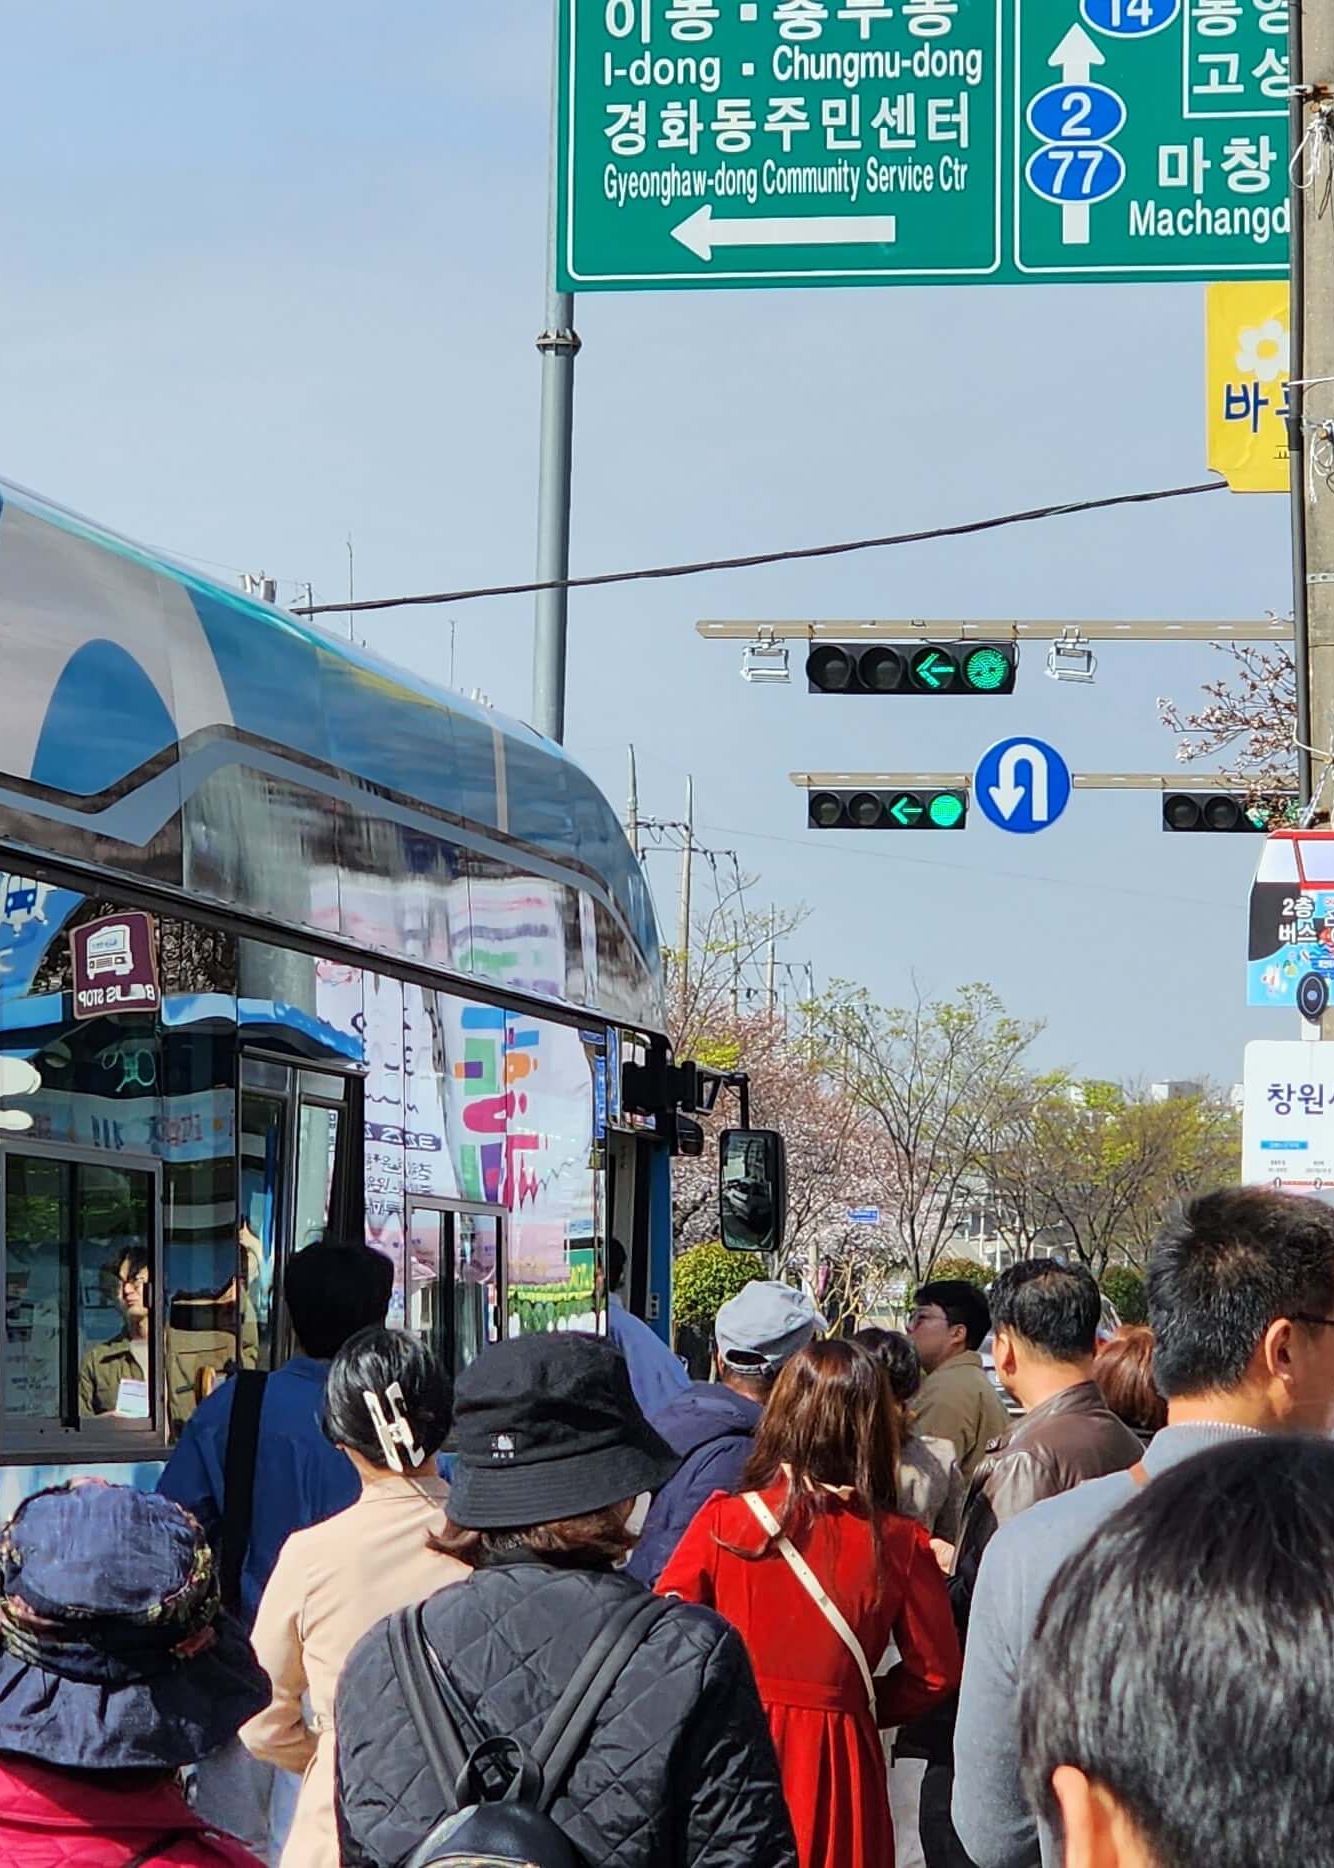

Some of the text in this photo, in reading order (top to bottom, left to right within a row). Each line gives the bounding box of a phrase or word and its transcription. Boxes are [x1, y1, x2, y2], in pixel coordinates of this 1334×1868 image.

[603, 43, 983, 92] I-dong Chungmu-dong
[603, 91, 971, 156] 경화동주민센터
[1061, 92, 1093, 137] 2
[763, 157, 860, 202] Community
[866, 155, 933, 193] Service
[939, 154, 969, 191] Ctr
[1047, 150, 1104, 195] 77
[1281, 897, 1315, 917] 2층
[1278, 922, 1317, 944] 버스
